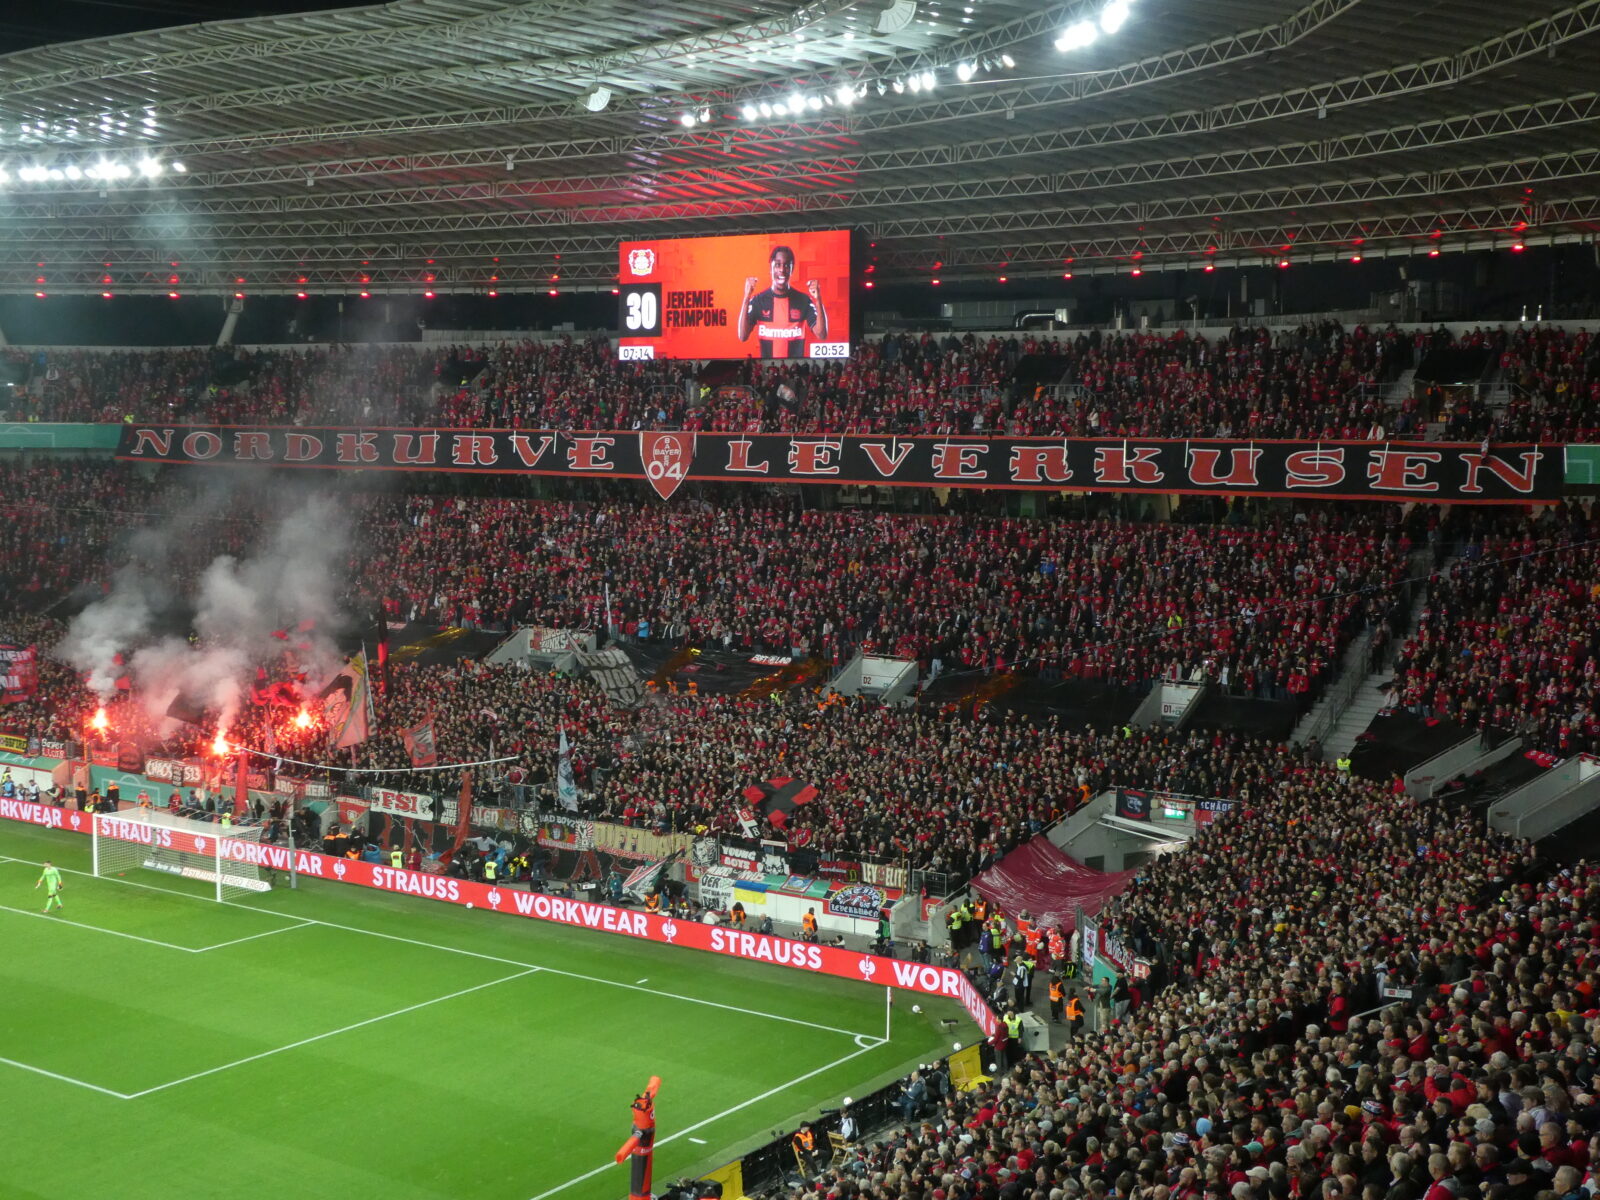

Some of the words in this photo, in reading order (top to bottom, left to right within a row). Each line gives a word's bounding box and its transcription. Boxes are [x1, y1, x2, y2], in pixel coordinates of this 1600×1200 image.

[666, 290, 714, 309] JEREMIE
[626, 292, 657, 330] 30
[666, 308, 727, 328] FRIMPONG
[758, 325, 802, 338] Barmenia
[623, 348, 650, 359] 07:14
[814, 345, 845, 356] 20:52
[131, 429, 615, 470] NORDKURVE
[724, 440, 1544, 493] LEVERKUSEN
[654, 448, 680, 456] BAYER
[648, 460, 683, 480] 04
[372, 866, 460, 900] STRAUSS
[513, 892, 648, 937] WORKWEAR
[710, 928, 822, 969] STRAUSS
